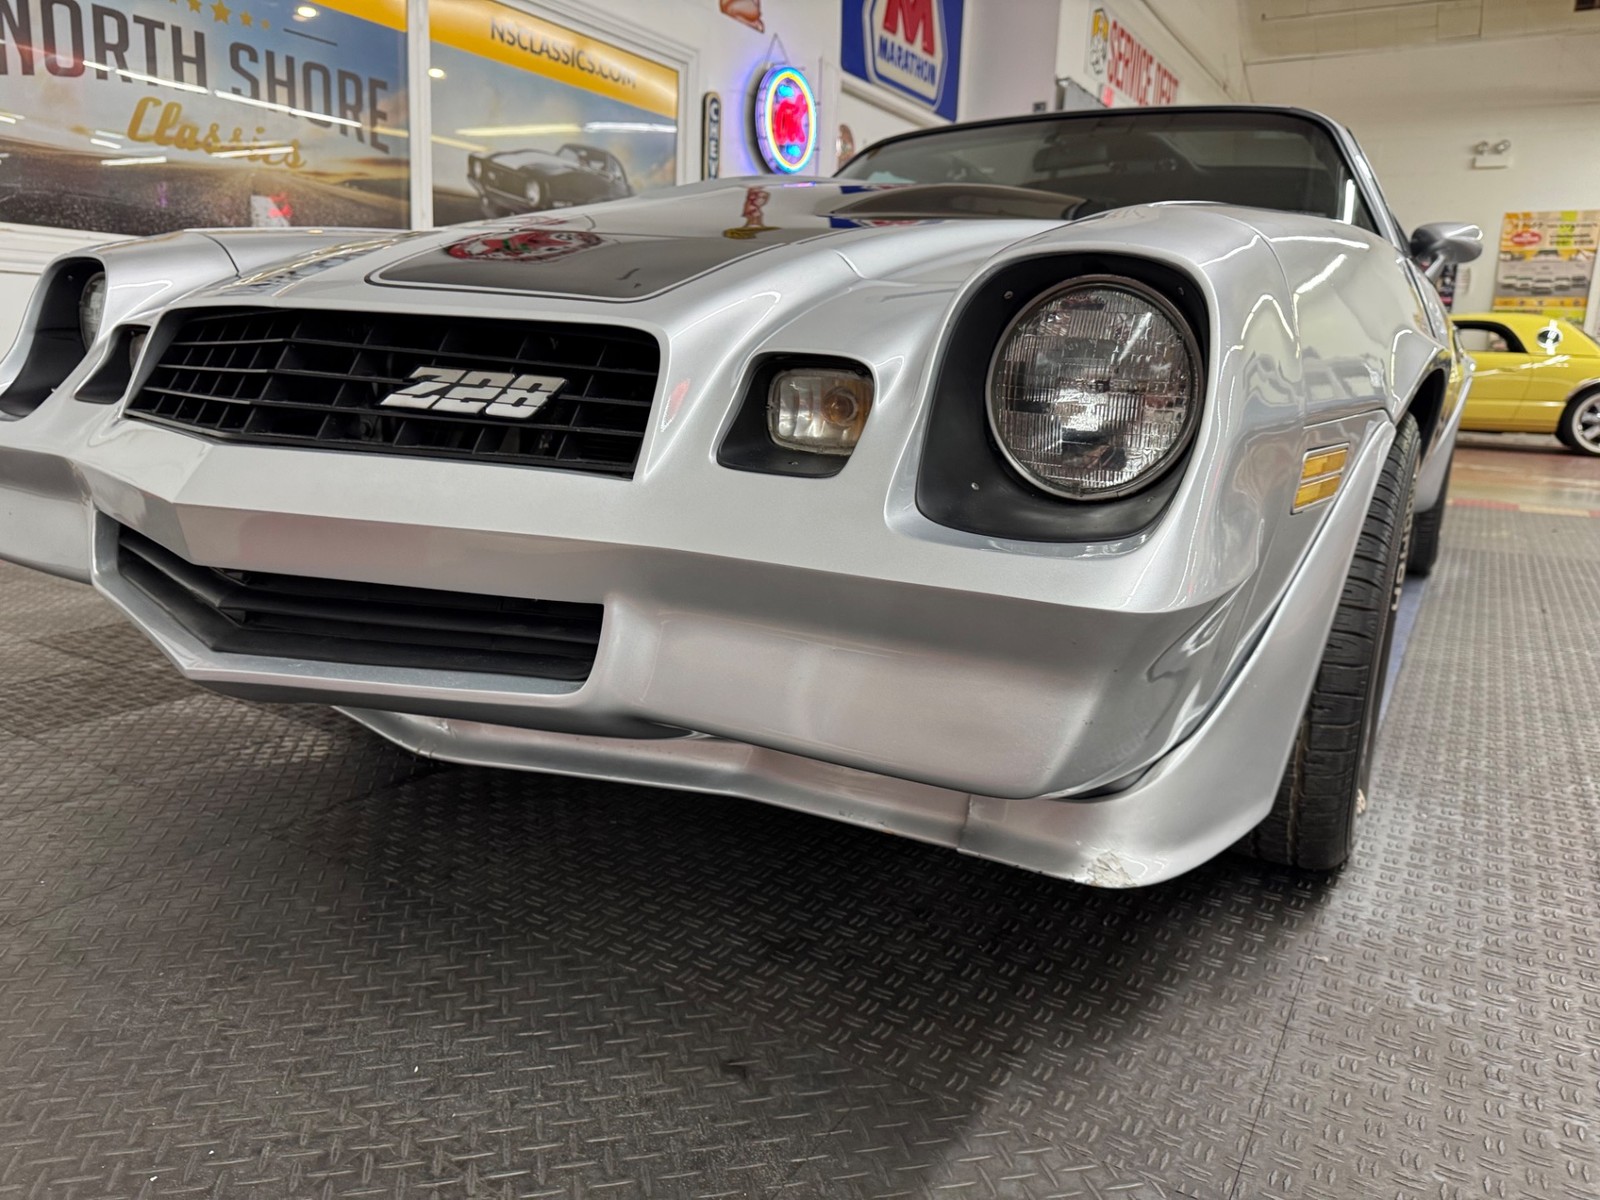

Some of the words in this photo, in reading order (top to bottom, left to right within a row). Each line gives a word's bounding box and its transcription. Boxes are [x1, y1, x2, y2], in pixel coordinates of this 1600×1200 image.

[490, 17, 637, 89] NSCLASSICS.COM
[878, 34, 936, 86] MARATHON
[883, 0, 935, 57] M
[1107, 20, 1153, 106] SERVICE
[0, 0, 208, 92] NORTH
[229, 41, 390, 154] SHORE
[127, 96, 307, 169] Classics
[379, 365, 569, 418] Z28
